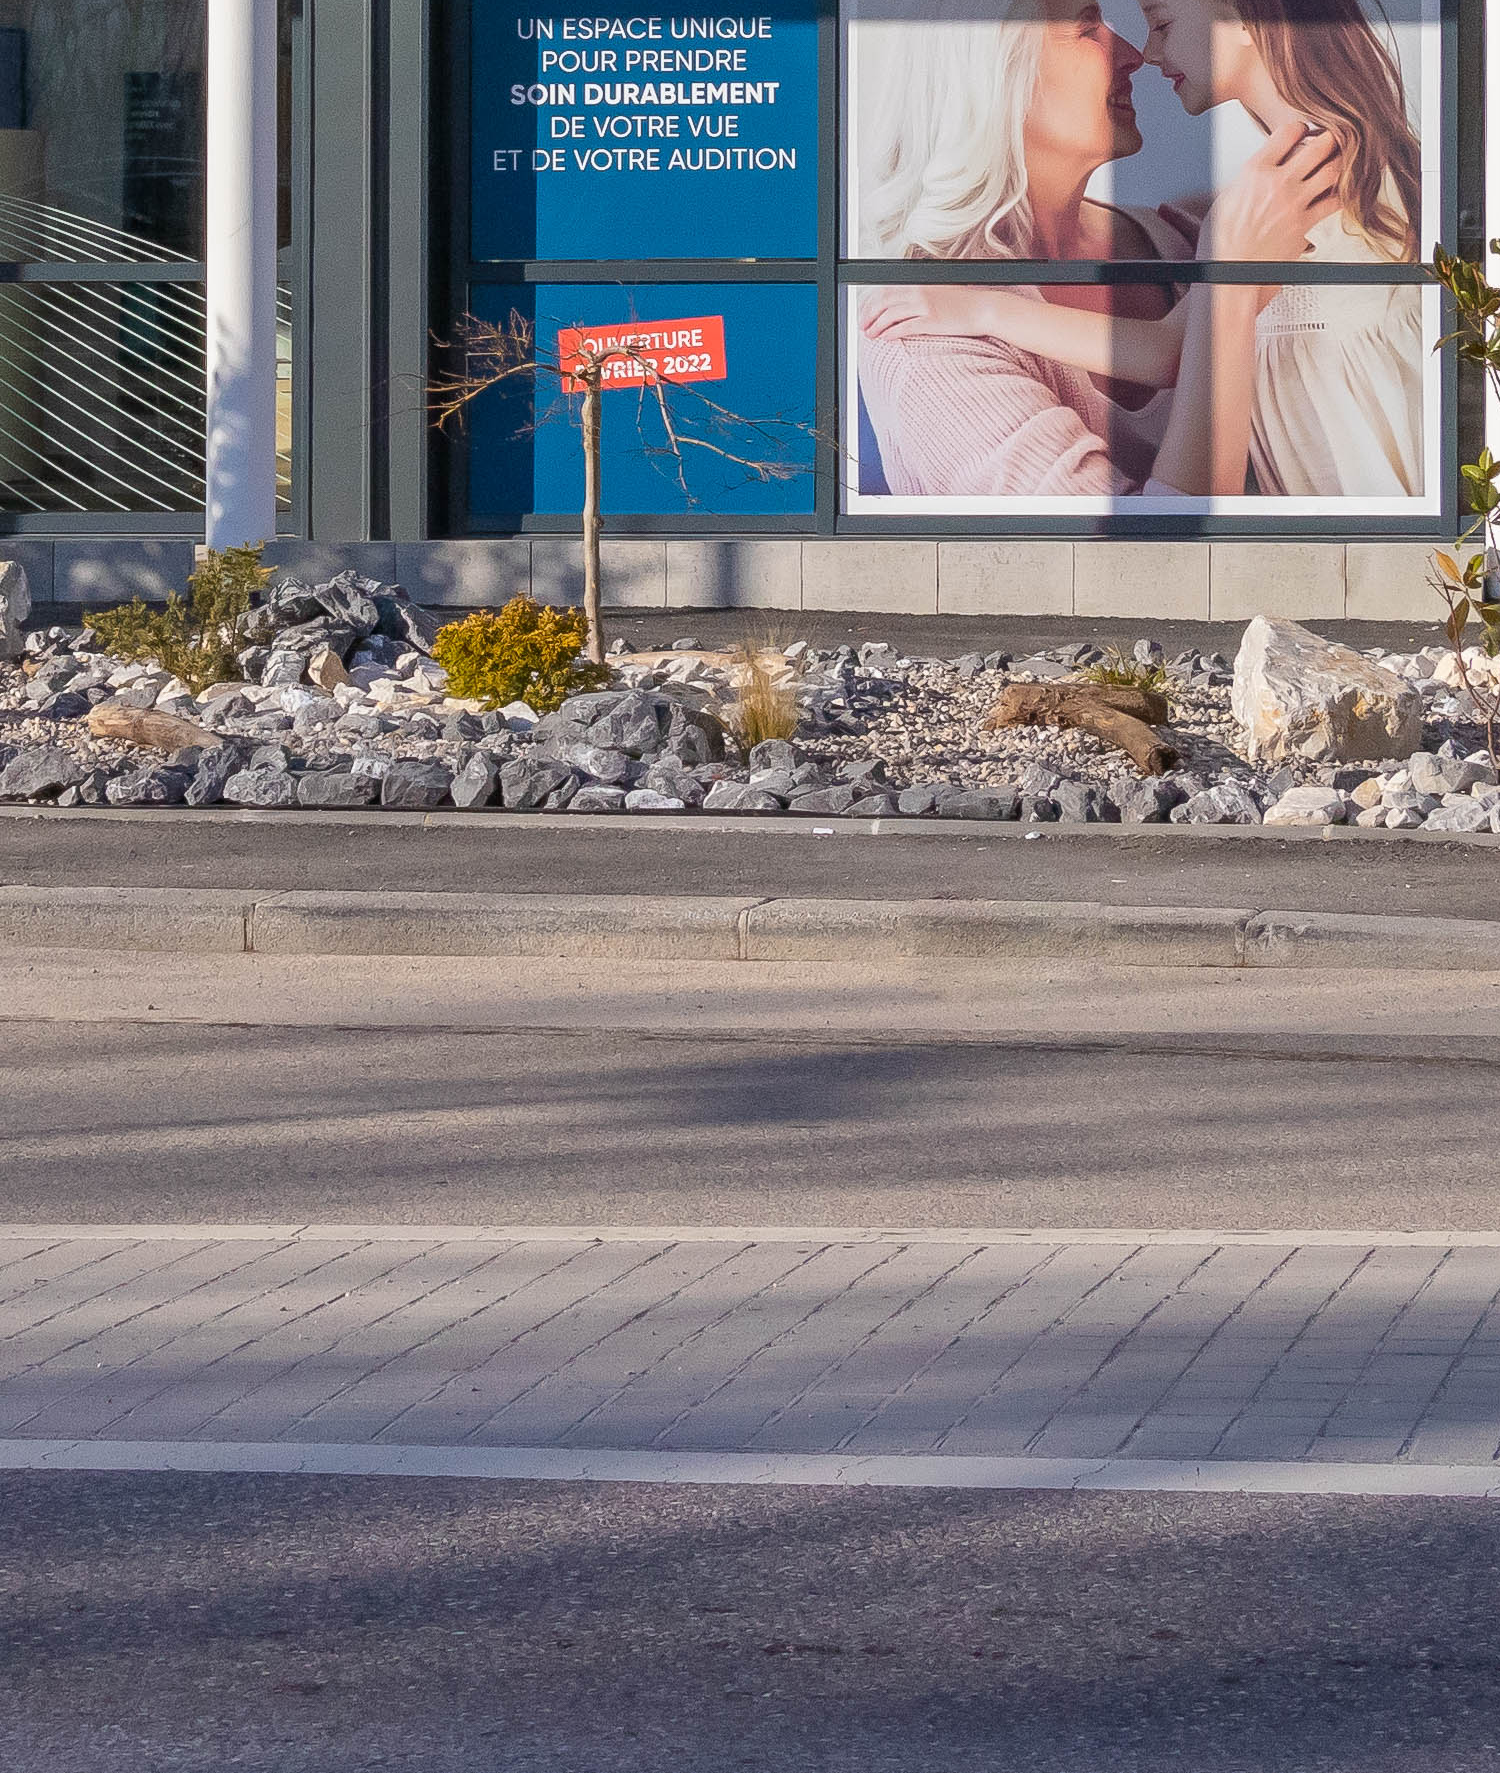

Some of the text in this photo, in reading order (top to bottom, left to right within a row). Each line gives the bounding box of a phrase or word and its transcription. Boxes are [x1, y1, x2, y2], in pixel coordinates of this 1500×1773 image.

[517, 17, 773, 40] UN ESPACE UNIQUE
[542, 49, 748, 73] POUR PRENDRE
[510, 82, 780, 106] SOIN DURABLEMENT
[551, 115, 739, 139] DE VOTRE VUE
[493, 147, 797, 171] ET DE VOTRE AUDITION
[583, 328, 704, 354] OUVERTURE
[663, 353, 713, 376] 2022
